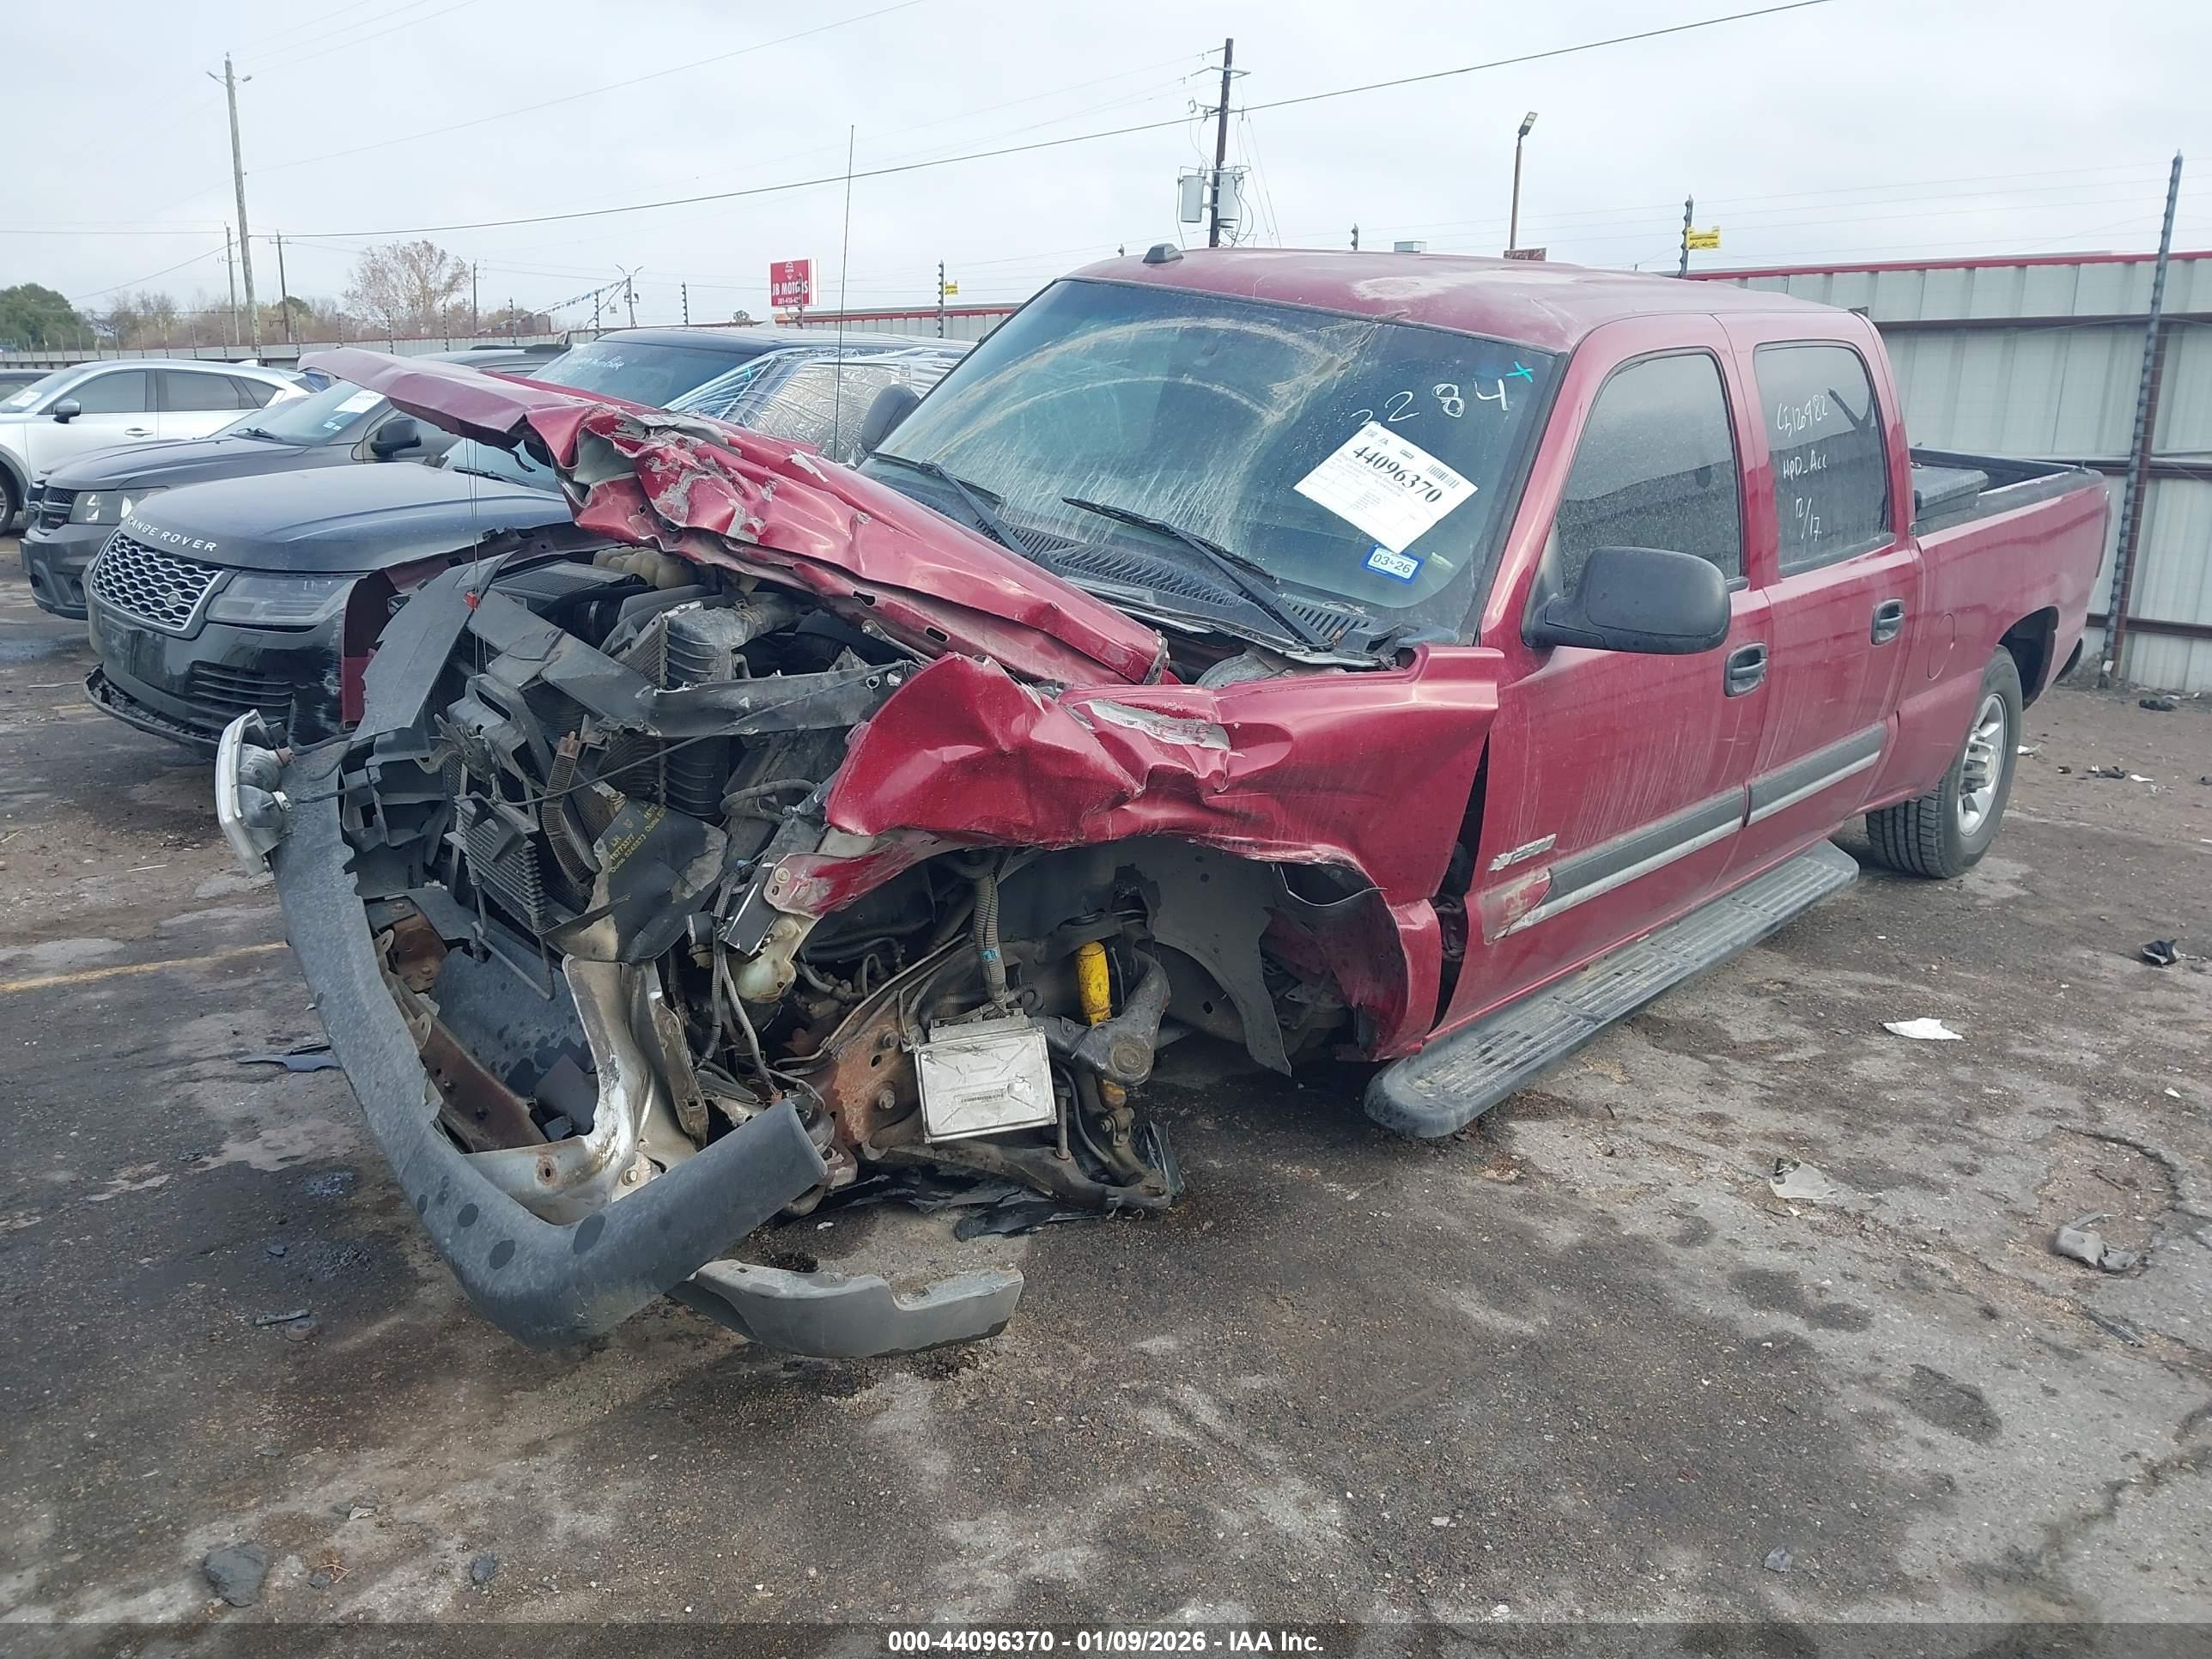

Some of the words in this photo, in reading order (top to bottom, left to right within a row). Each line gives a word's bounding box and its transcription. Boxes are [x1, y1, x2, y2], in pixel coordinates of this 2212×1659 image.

[772, 283, 780, 296] JB
[1350, 378, 1510, 427] 2284
[1352, 446, 1443, 503] 44096370
[126, 515, 159, 537] RANGE
[160, 531, 217, 552] ROVER
[1795, 496, 1823, 543] 12/17
